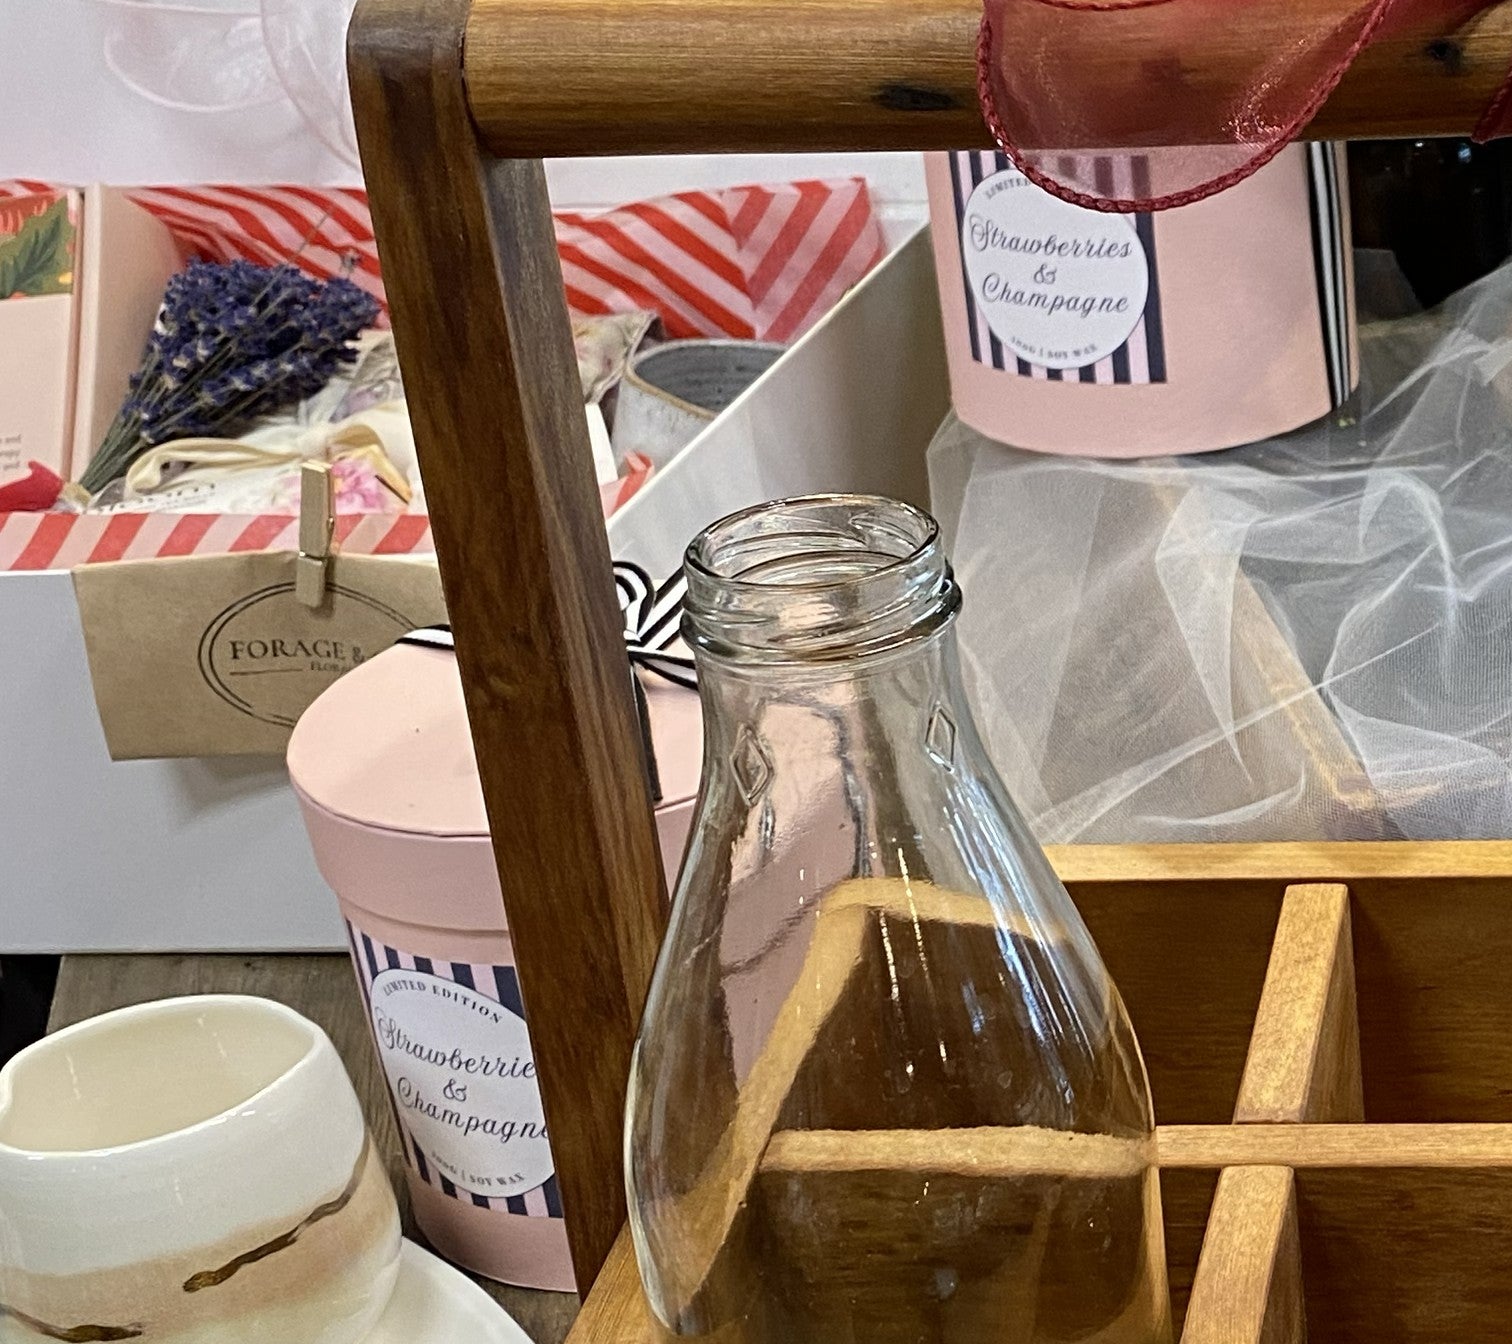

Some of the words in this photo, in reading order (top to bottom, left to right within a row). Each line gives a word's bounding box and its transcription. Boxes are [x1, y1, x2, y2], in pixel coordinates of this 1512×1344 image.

[969, 212, 1133, 259] Strawberries
[1033, 263, 1058, 285] &
[981, 271, 1129, 318] Champagne
[229, 639, 346, 660] FORAGE
[433, 986, 502, 1024] EDITION
[374, 1006, 537, 1079] Strawberrie
[442, 1078, 468, 1103] &
